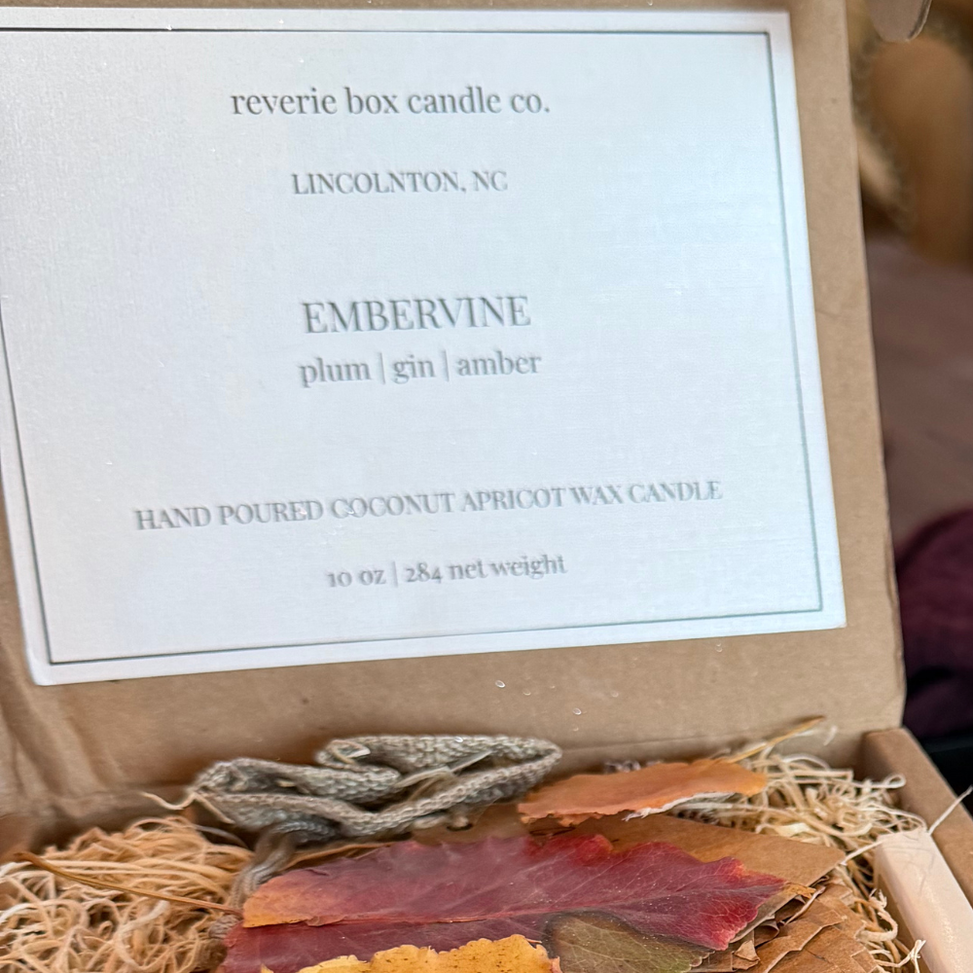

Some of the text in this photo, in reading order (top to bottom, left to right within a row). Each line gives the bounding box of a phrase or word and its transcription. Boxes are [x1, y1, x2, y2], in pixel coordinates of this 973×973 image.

[231, 86, 551, 115] reverie box candle co.
[291, 171, 508, 195] LINCOLNTON, NC
[302, 296, 531, 334] EMBERVINE
[299, 357, 372, 388] plum
[392, 355, 436, 385] gin
[457, 350, 542, 377] amber
[135, 481, 723, 530] HAND POURED COCONUT APRICOT WAX CANDLE
[327, 571, 353, 588] 10
[358, 569, 387, 586] oz
[406, 561, 443, 584] 284
[449, 559, 488, 580] net
[491, 553, 568, 580] weight
